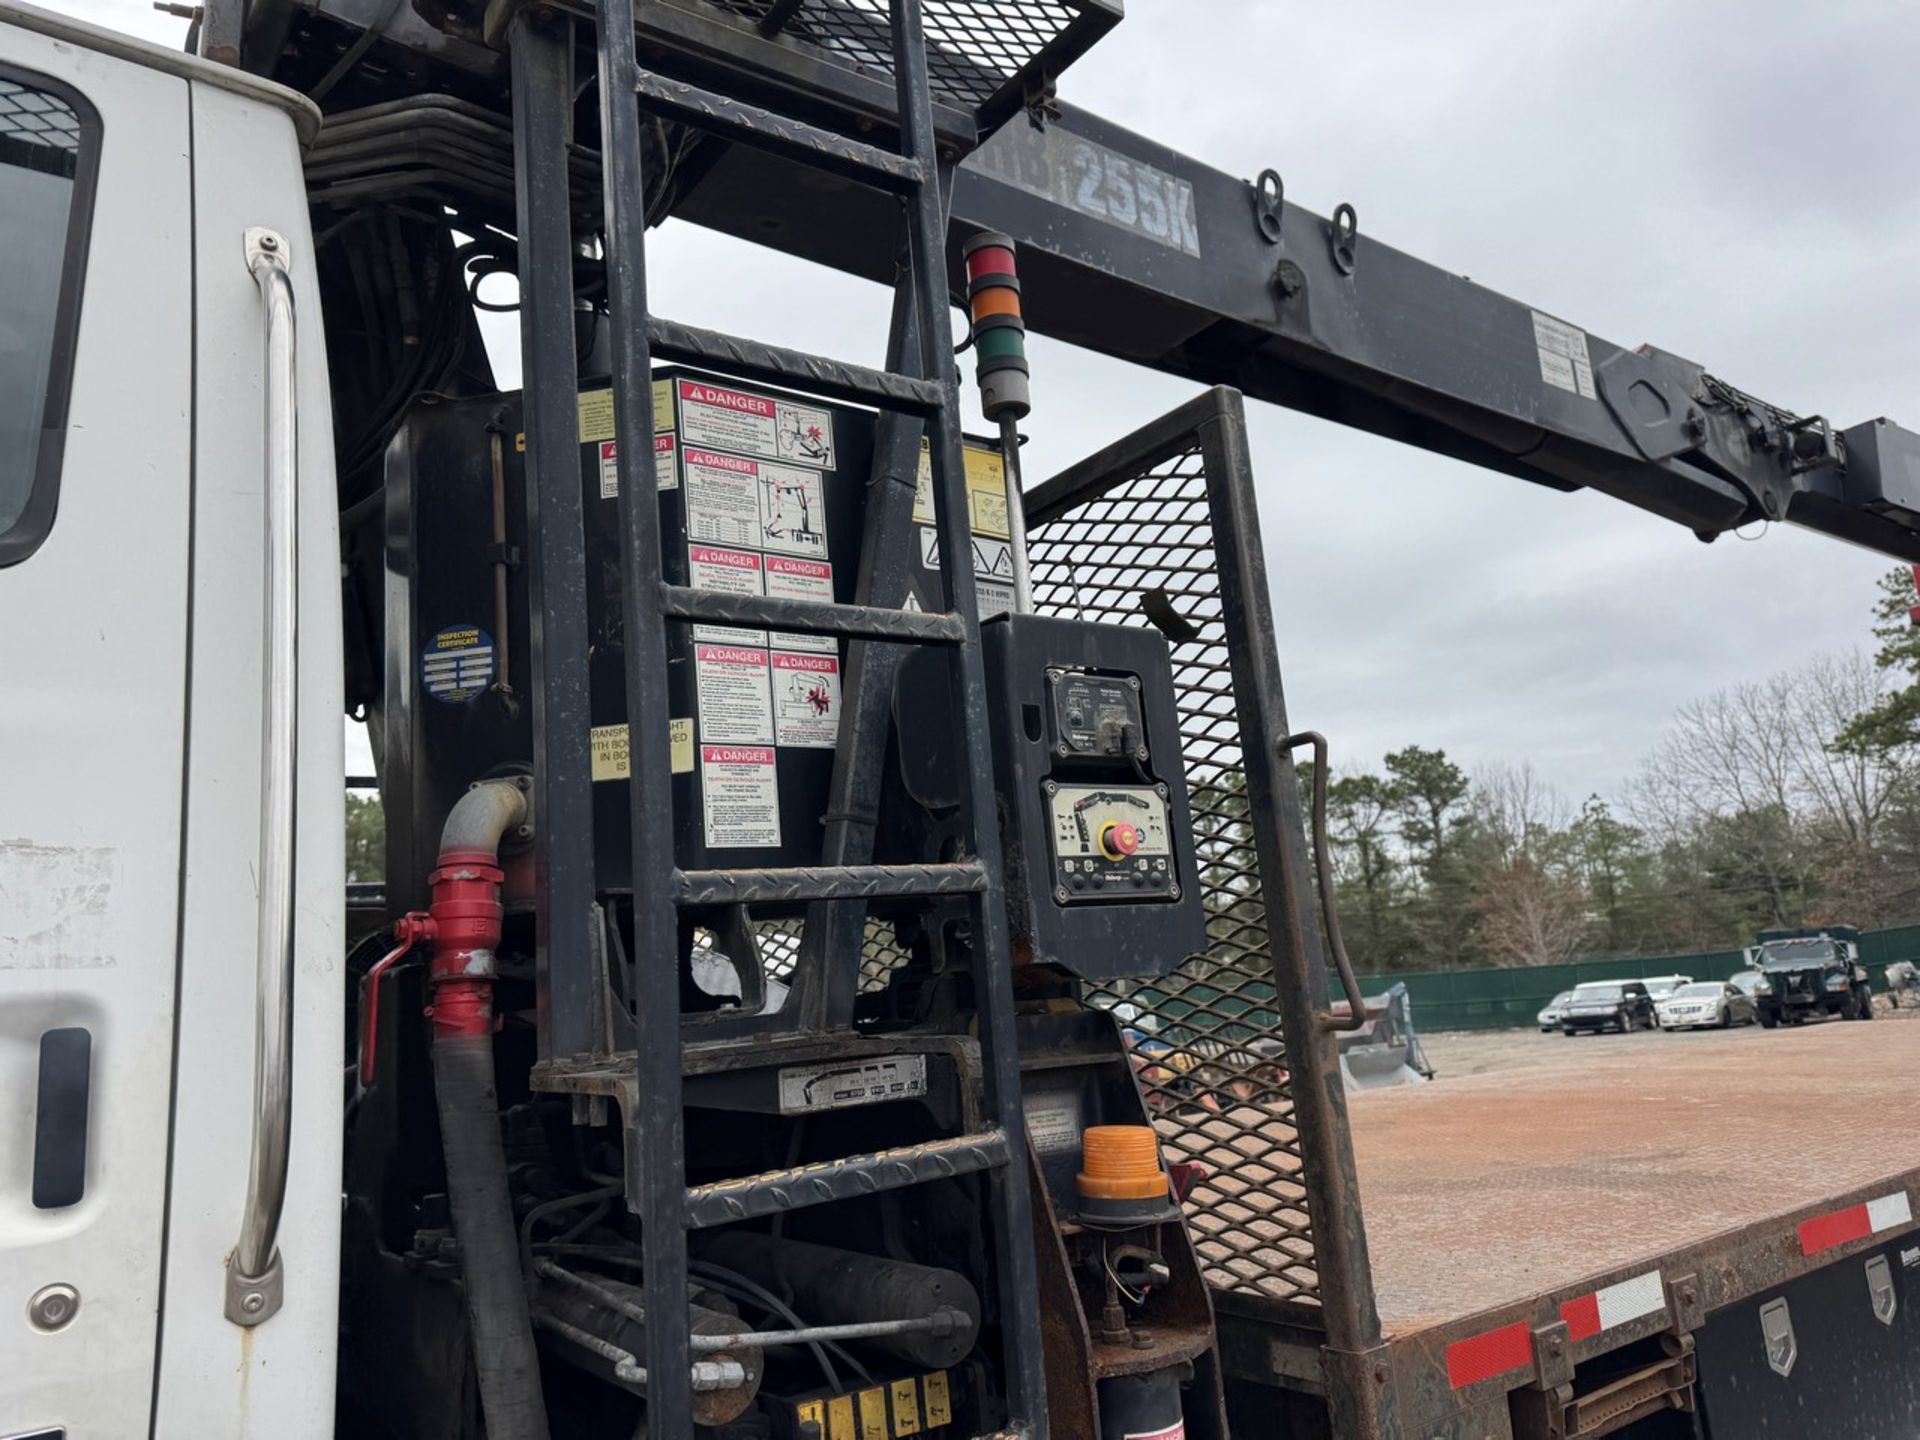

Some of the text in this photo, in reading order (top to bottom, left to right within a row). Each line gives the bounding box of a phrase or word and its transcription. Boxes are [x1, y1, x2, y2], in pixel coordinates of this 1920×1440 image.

[705, 390, 767, 413] DANGER
[704, 455, 751, 472] DANGER
[710, 551, 754, 567] DANGER
[784, 562, 825, 576] DANGER
[437, 629, 479, 640] INSPECTION
[437, 637, 478, 648] CERTIFICATE
[718, 650, 762, 663] DANGER
[791, 657, 832, 670] DANGER
[593, 739, 628, 751] ITH BO
[600, 751, 628, 761] IN BO
[723, 751, 767, 761] DANGER
